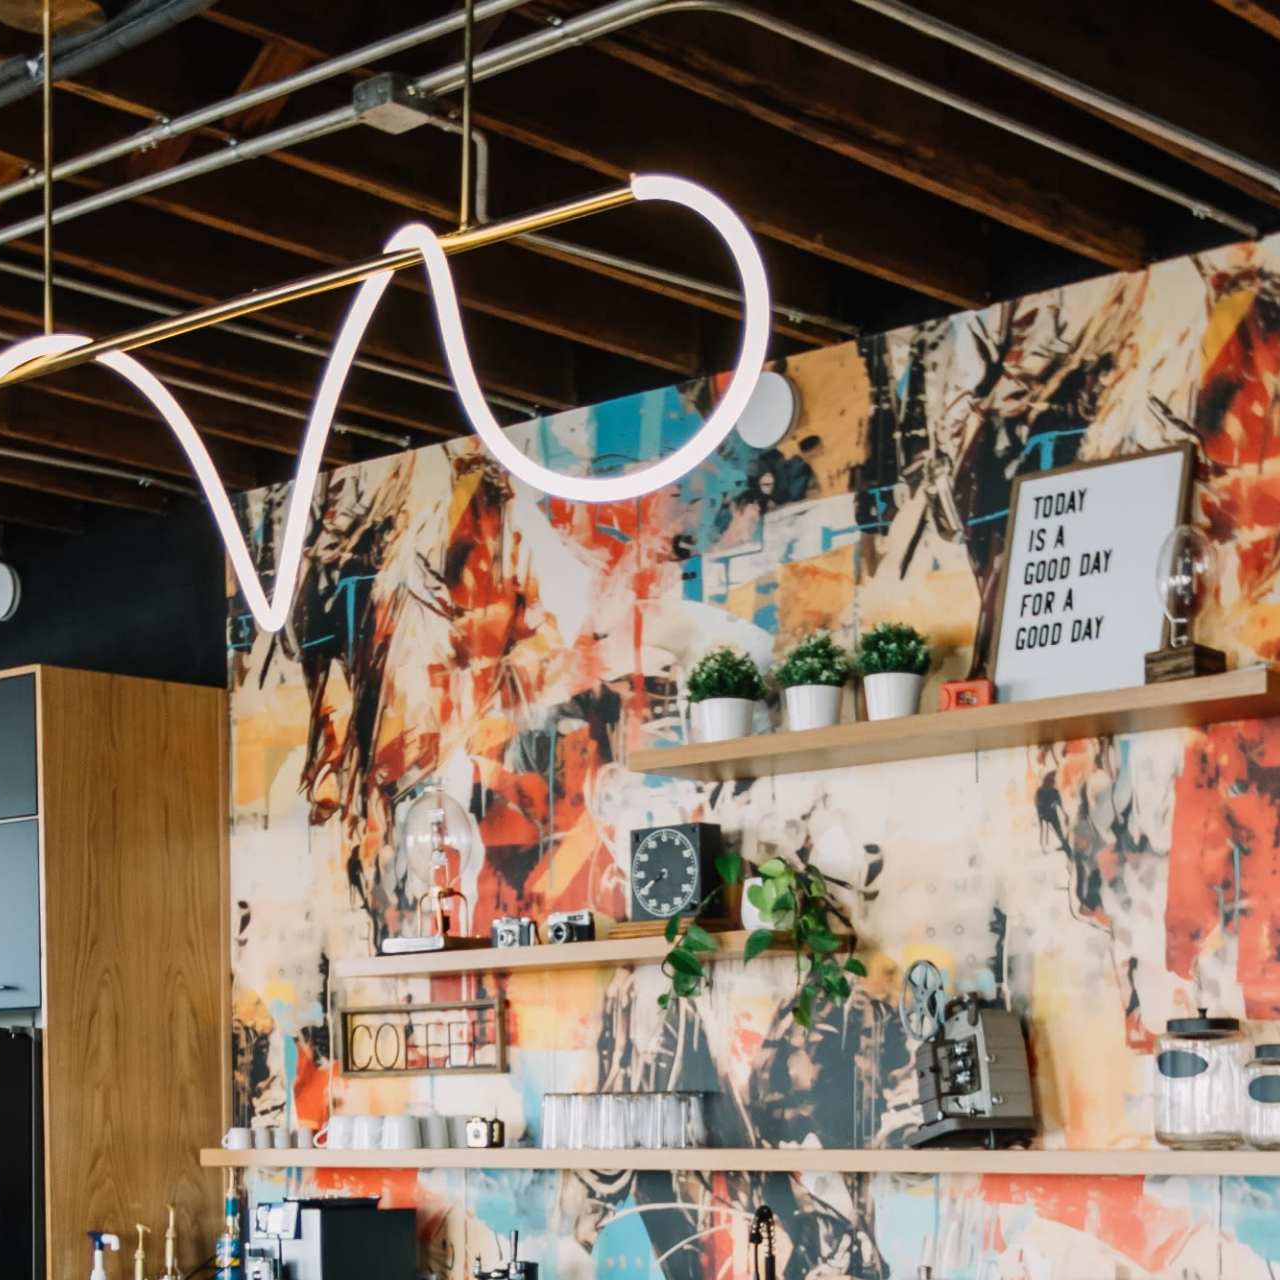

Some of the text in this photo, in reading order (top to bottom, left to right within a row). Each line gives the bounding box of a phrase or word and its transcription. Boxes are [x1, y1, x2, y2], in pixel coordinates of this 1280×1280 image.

[1033, 488, 1088, 520] TODAY
[1028, 524, 1066, 553] IS A
[1023, 549, 1113, 586] GOOD DAY
[1019, 587, 1074, 618] FOR A
[1015, 616, 1104, 651] GOOD DAY
[350, 1021, 497, 1073] COFFEE
